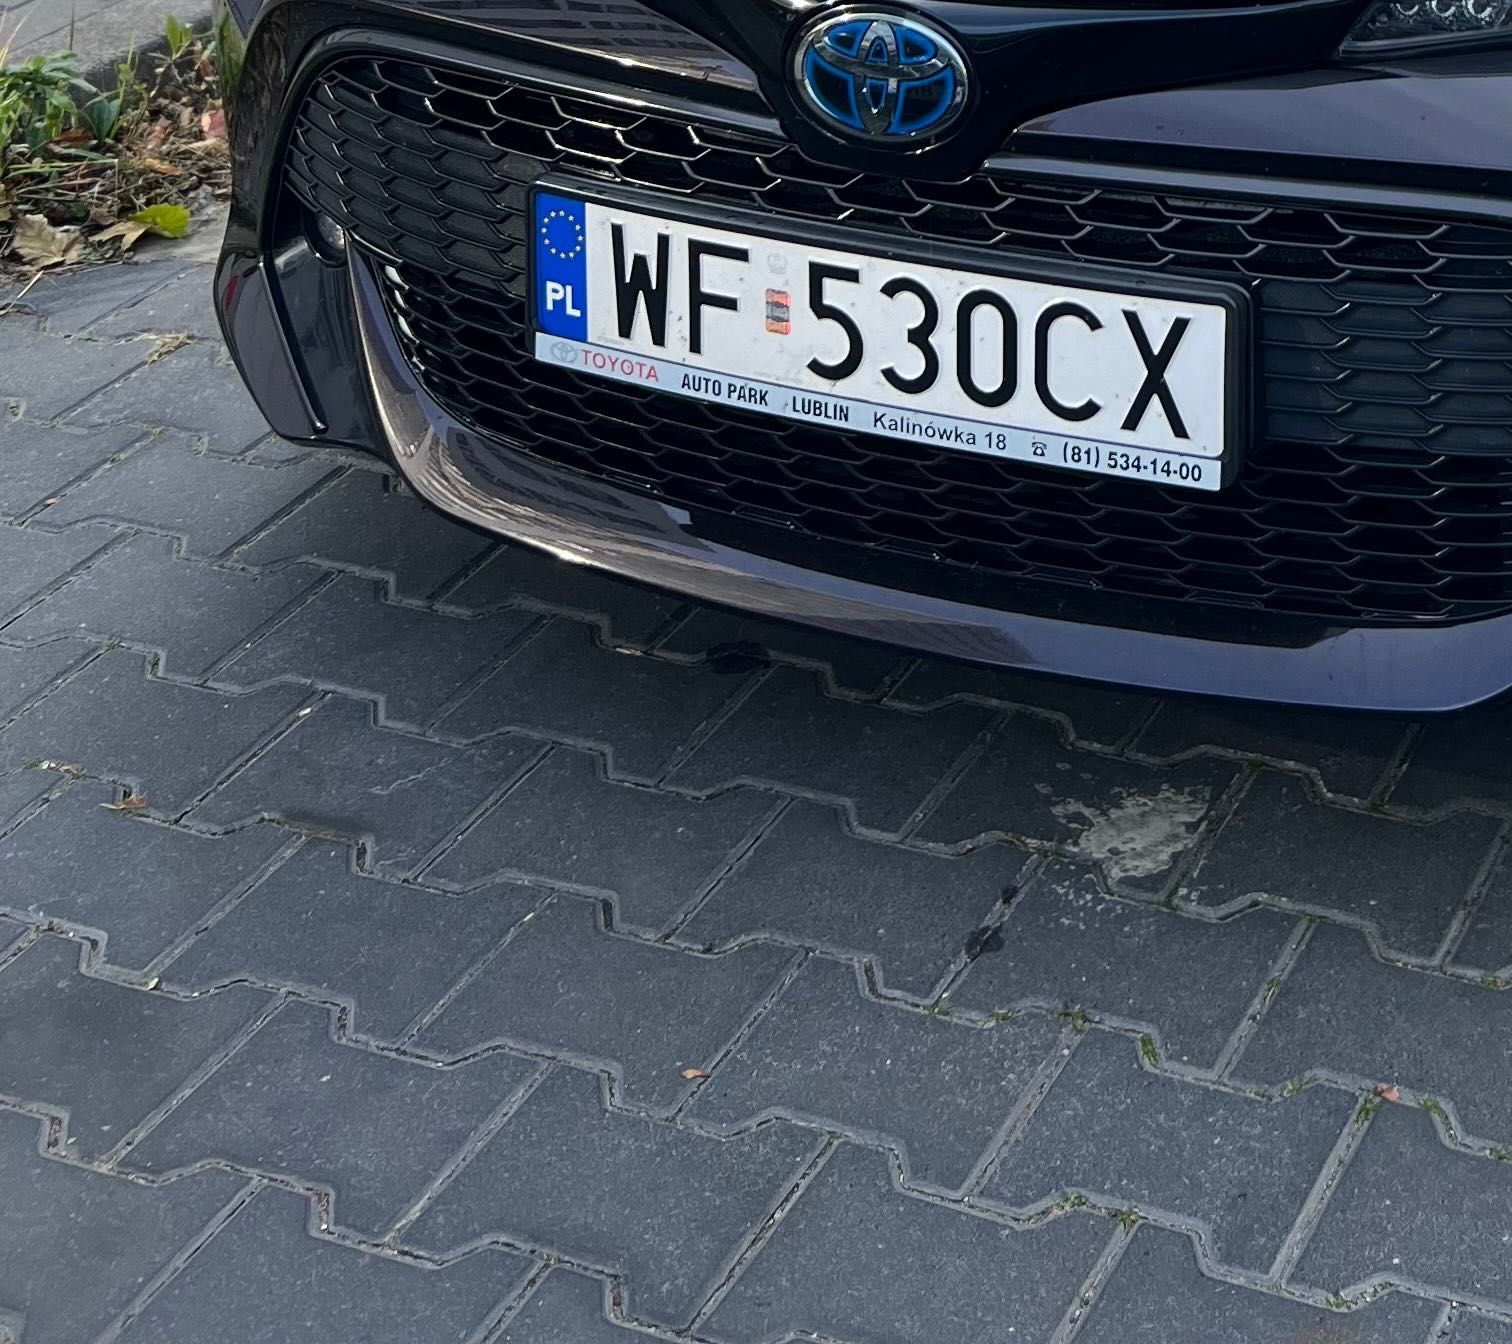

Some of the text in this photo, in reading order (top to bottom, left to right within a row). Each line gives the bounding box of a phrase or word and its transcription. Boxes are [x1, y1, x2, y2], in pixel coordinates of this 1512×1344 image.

[546, 280, 582, 318] PL
[611, 221, 1192, 441] WF 530CX
[581, 348, 1202, 483] TOYOTA AUTO PARK LUBLIN Kalinówka 18 (81) 534-14-00
